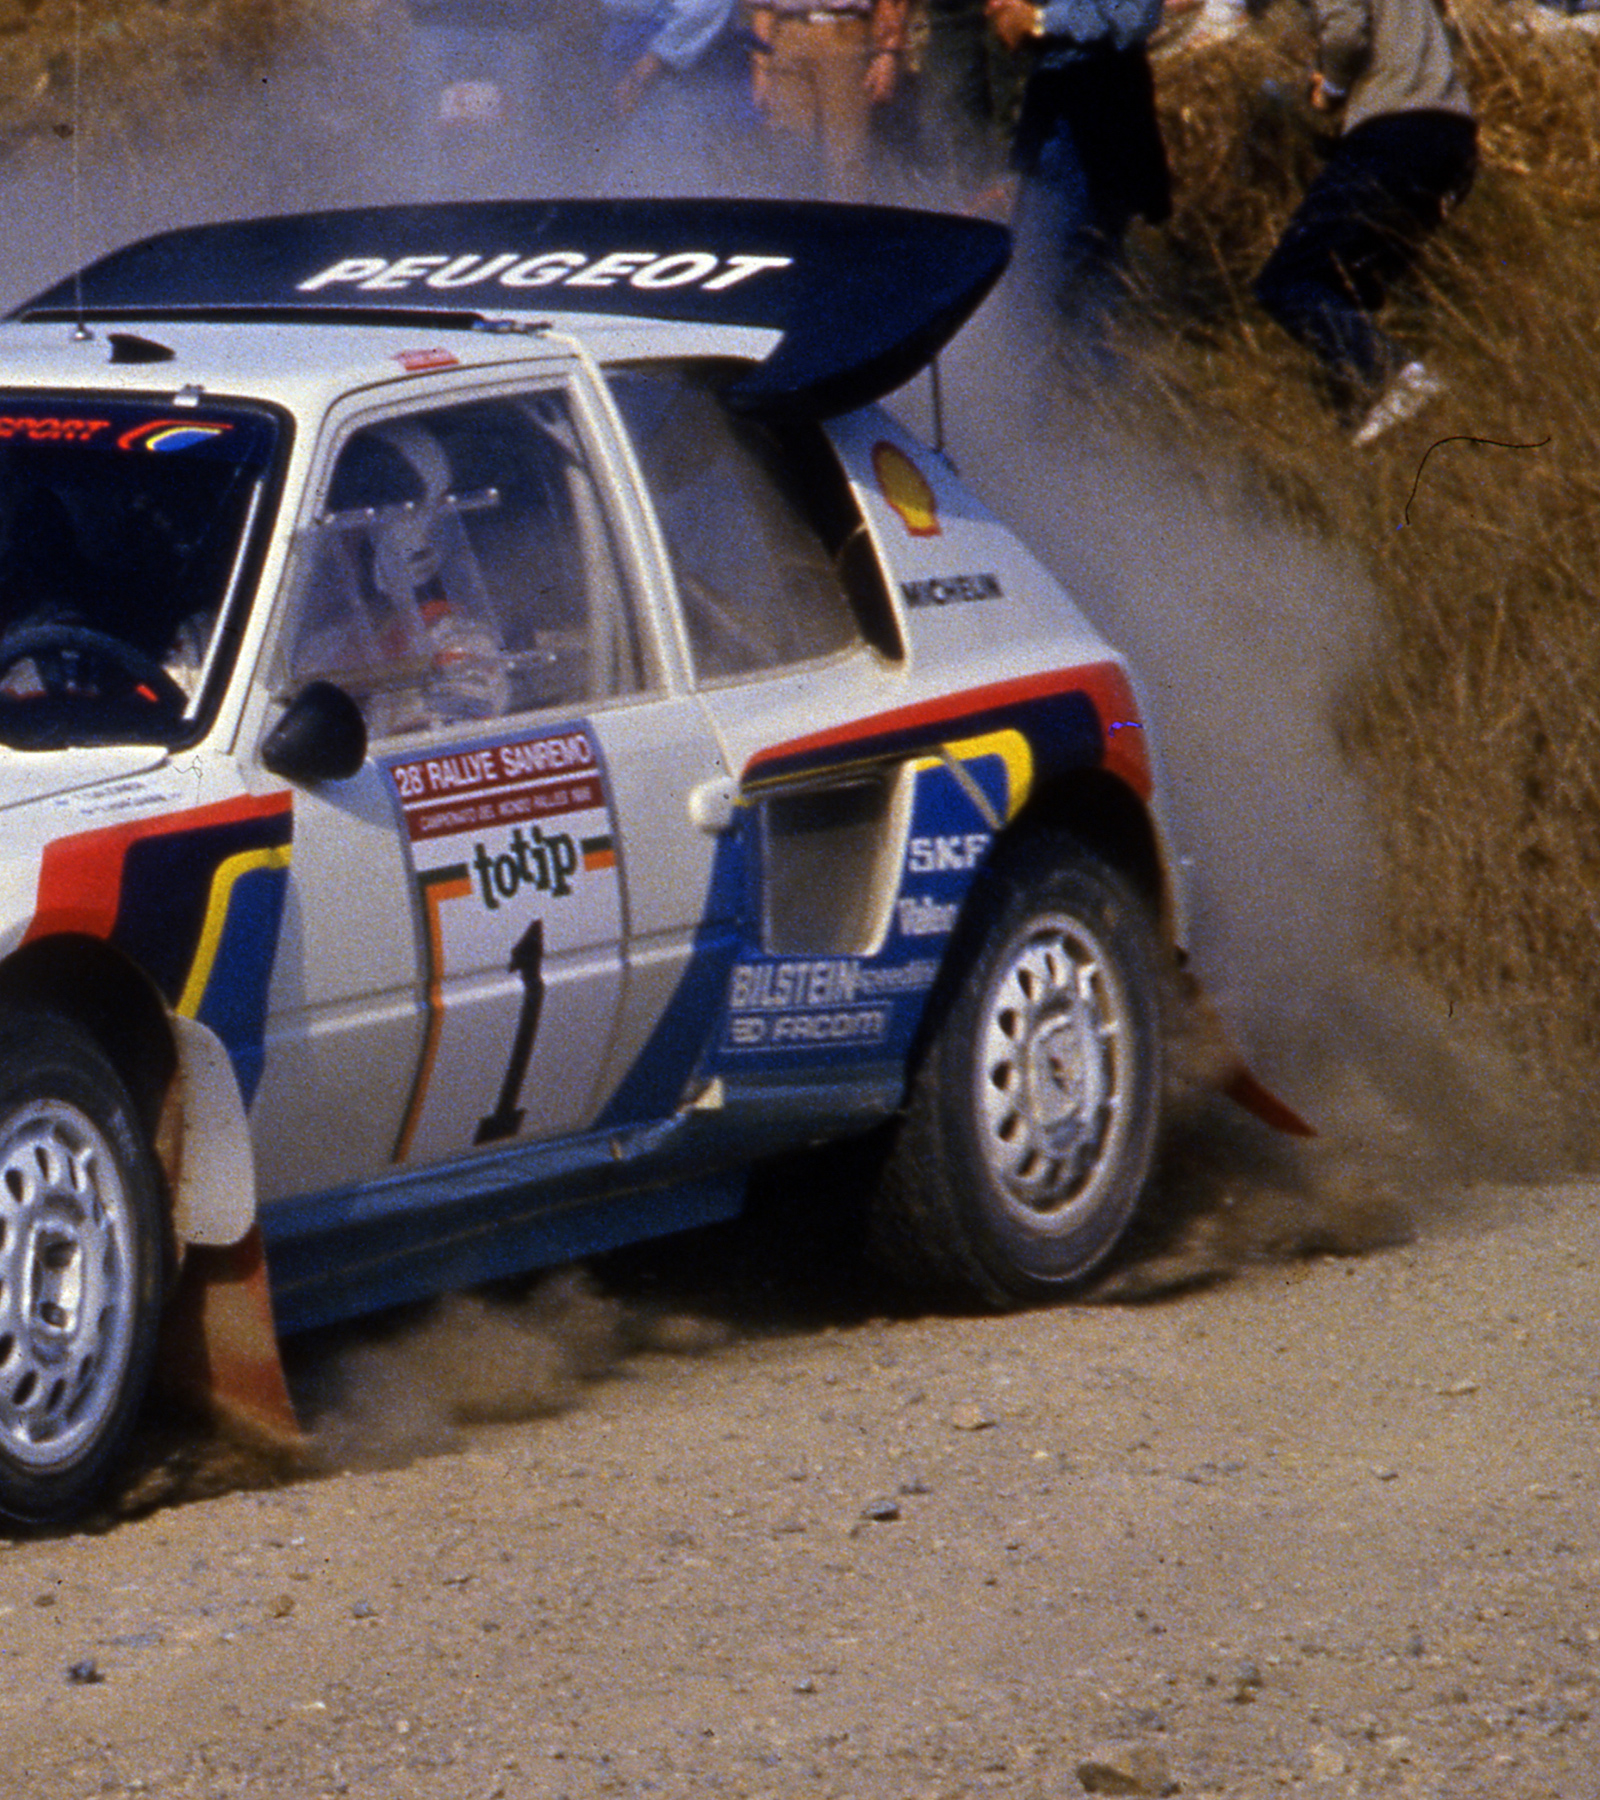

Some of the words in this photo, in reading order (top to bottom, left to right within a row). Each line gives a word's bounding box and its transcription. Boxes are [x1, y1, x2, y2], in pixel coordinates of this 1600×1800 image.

[297, 252, 793, 291] PEUGEOT
[426, 751, 499, 791] RALLYE
[500, 734, 593, 777] SANREMO
[908, 833, 991, 872] SKF
[473, 919, 544, 1146] 1
